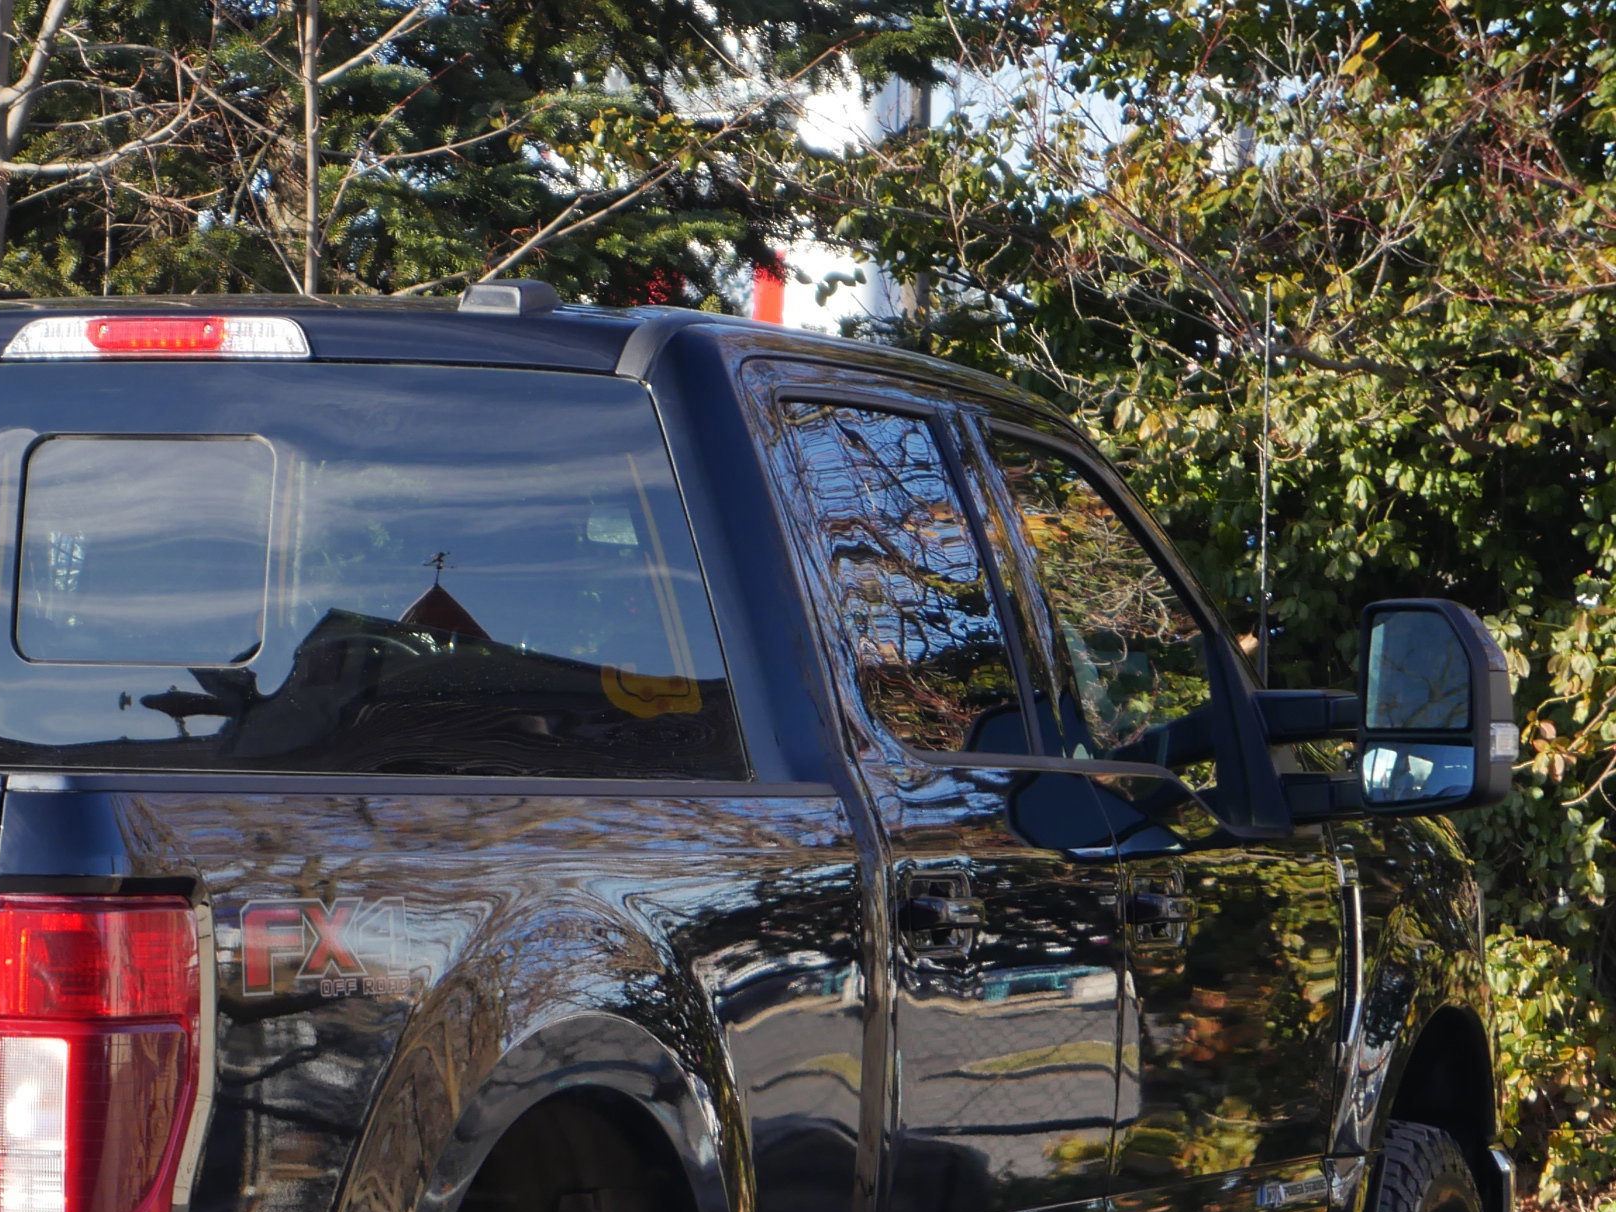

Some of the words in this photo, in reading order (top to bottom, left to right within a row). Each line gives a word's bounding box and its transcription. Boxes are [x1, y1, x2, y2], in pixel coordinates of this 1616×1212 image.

[240, 896, 410, 996] FX4
[320, 978, 358, 997] OFF
[362, 976, 410, 996] ROAD
